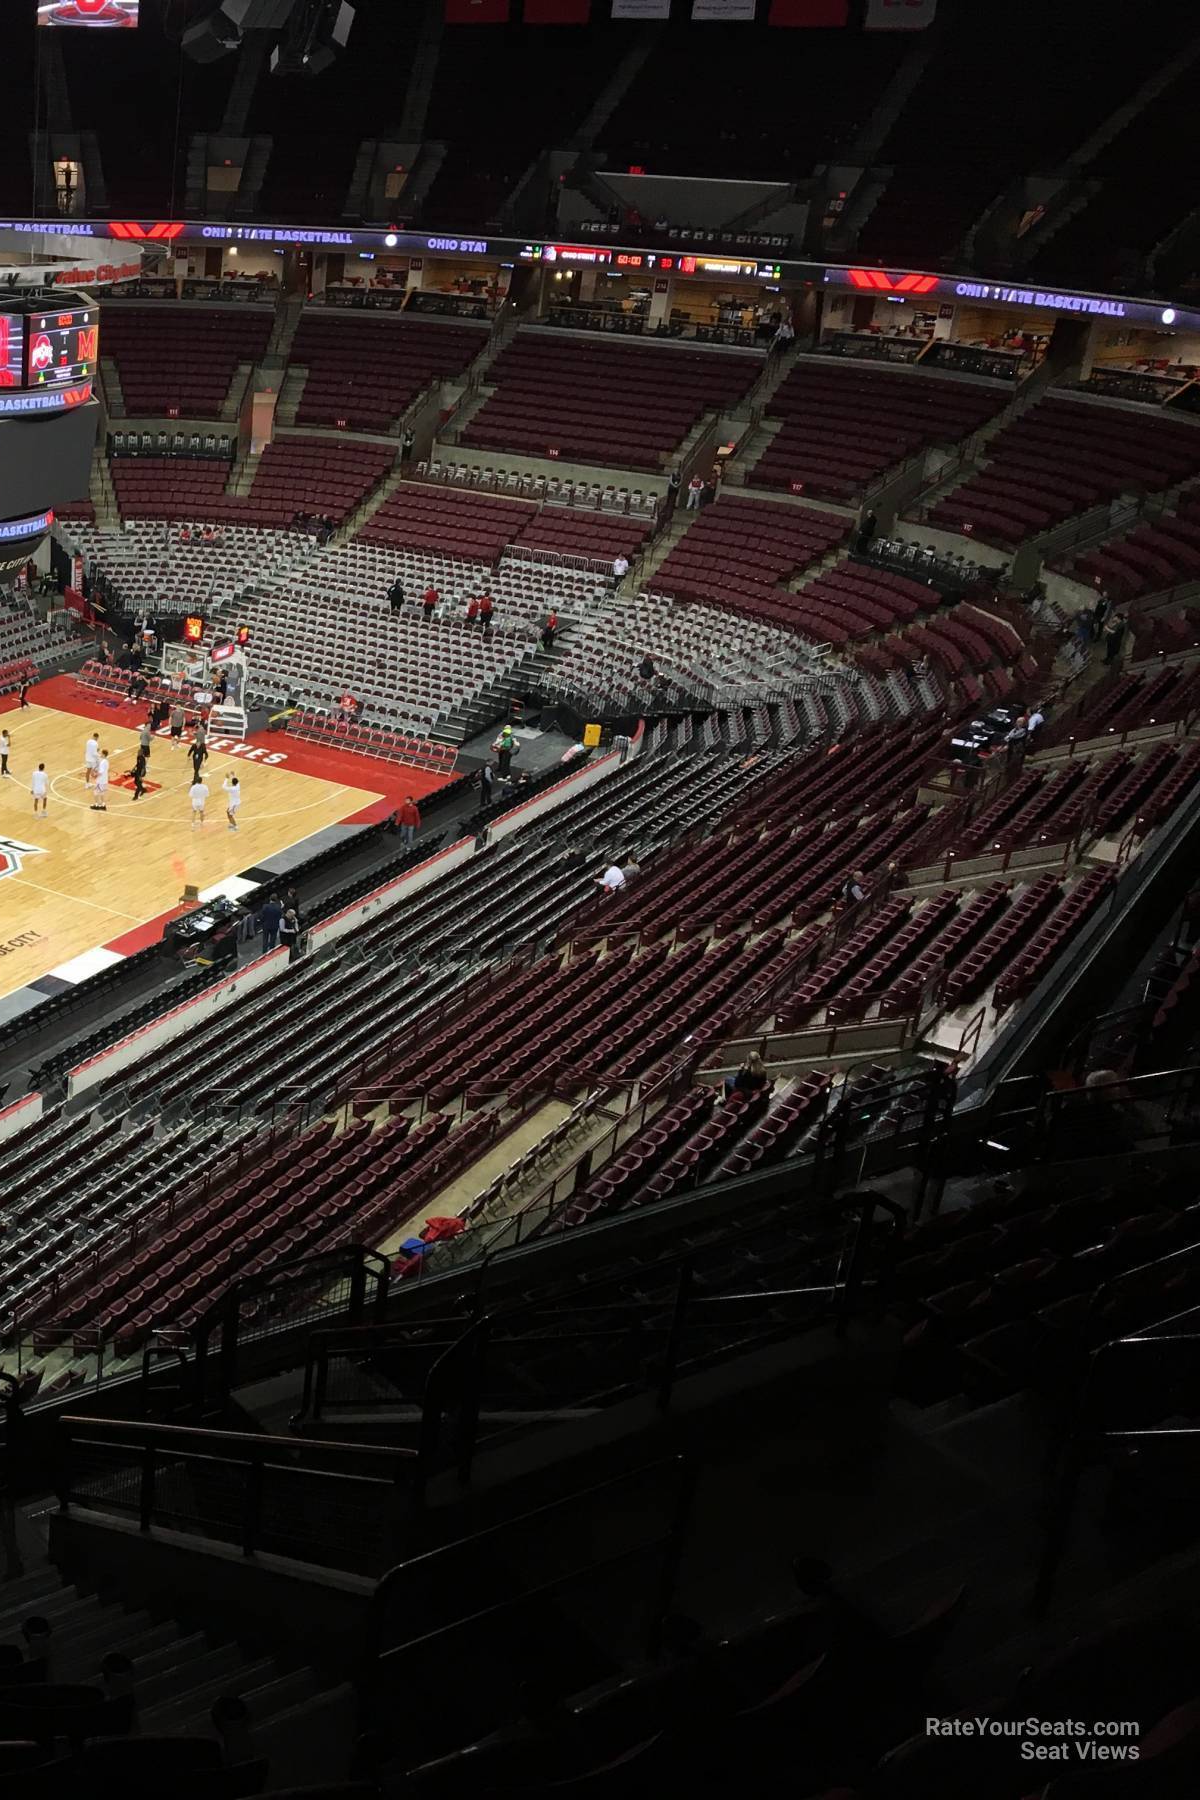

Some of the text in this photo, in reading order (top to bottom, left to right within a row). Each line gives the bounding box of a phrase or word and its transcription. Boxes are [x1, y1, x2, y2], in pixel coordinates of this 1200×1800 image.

[274, 230, 353, 244] BASKETBALL
[427, 238, 458, 251] OHIO
[617, 255, 642, 265] 60:00
[1034, 291, 1125, 317] BASKETBALL
[78, 328, 96, 361] M
[8, 930, 41, 948] CITY
